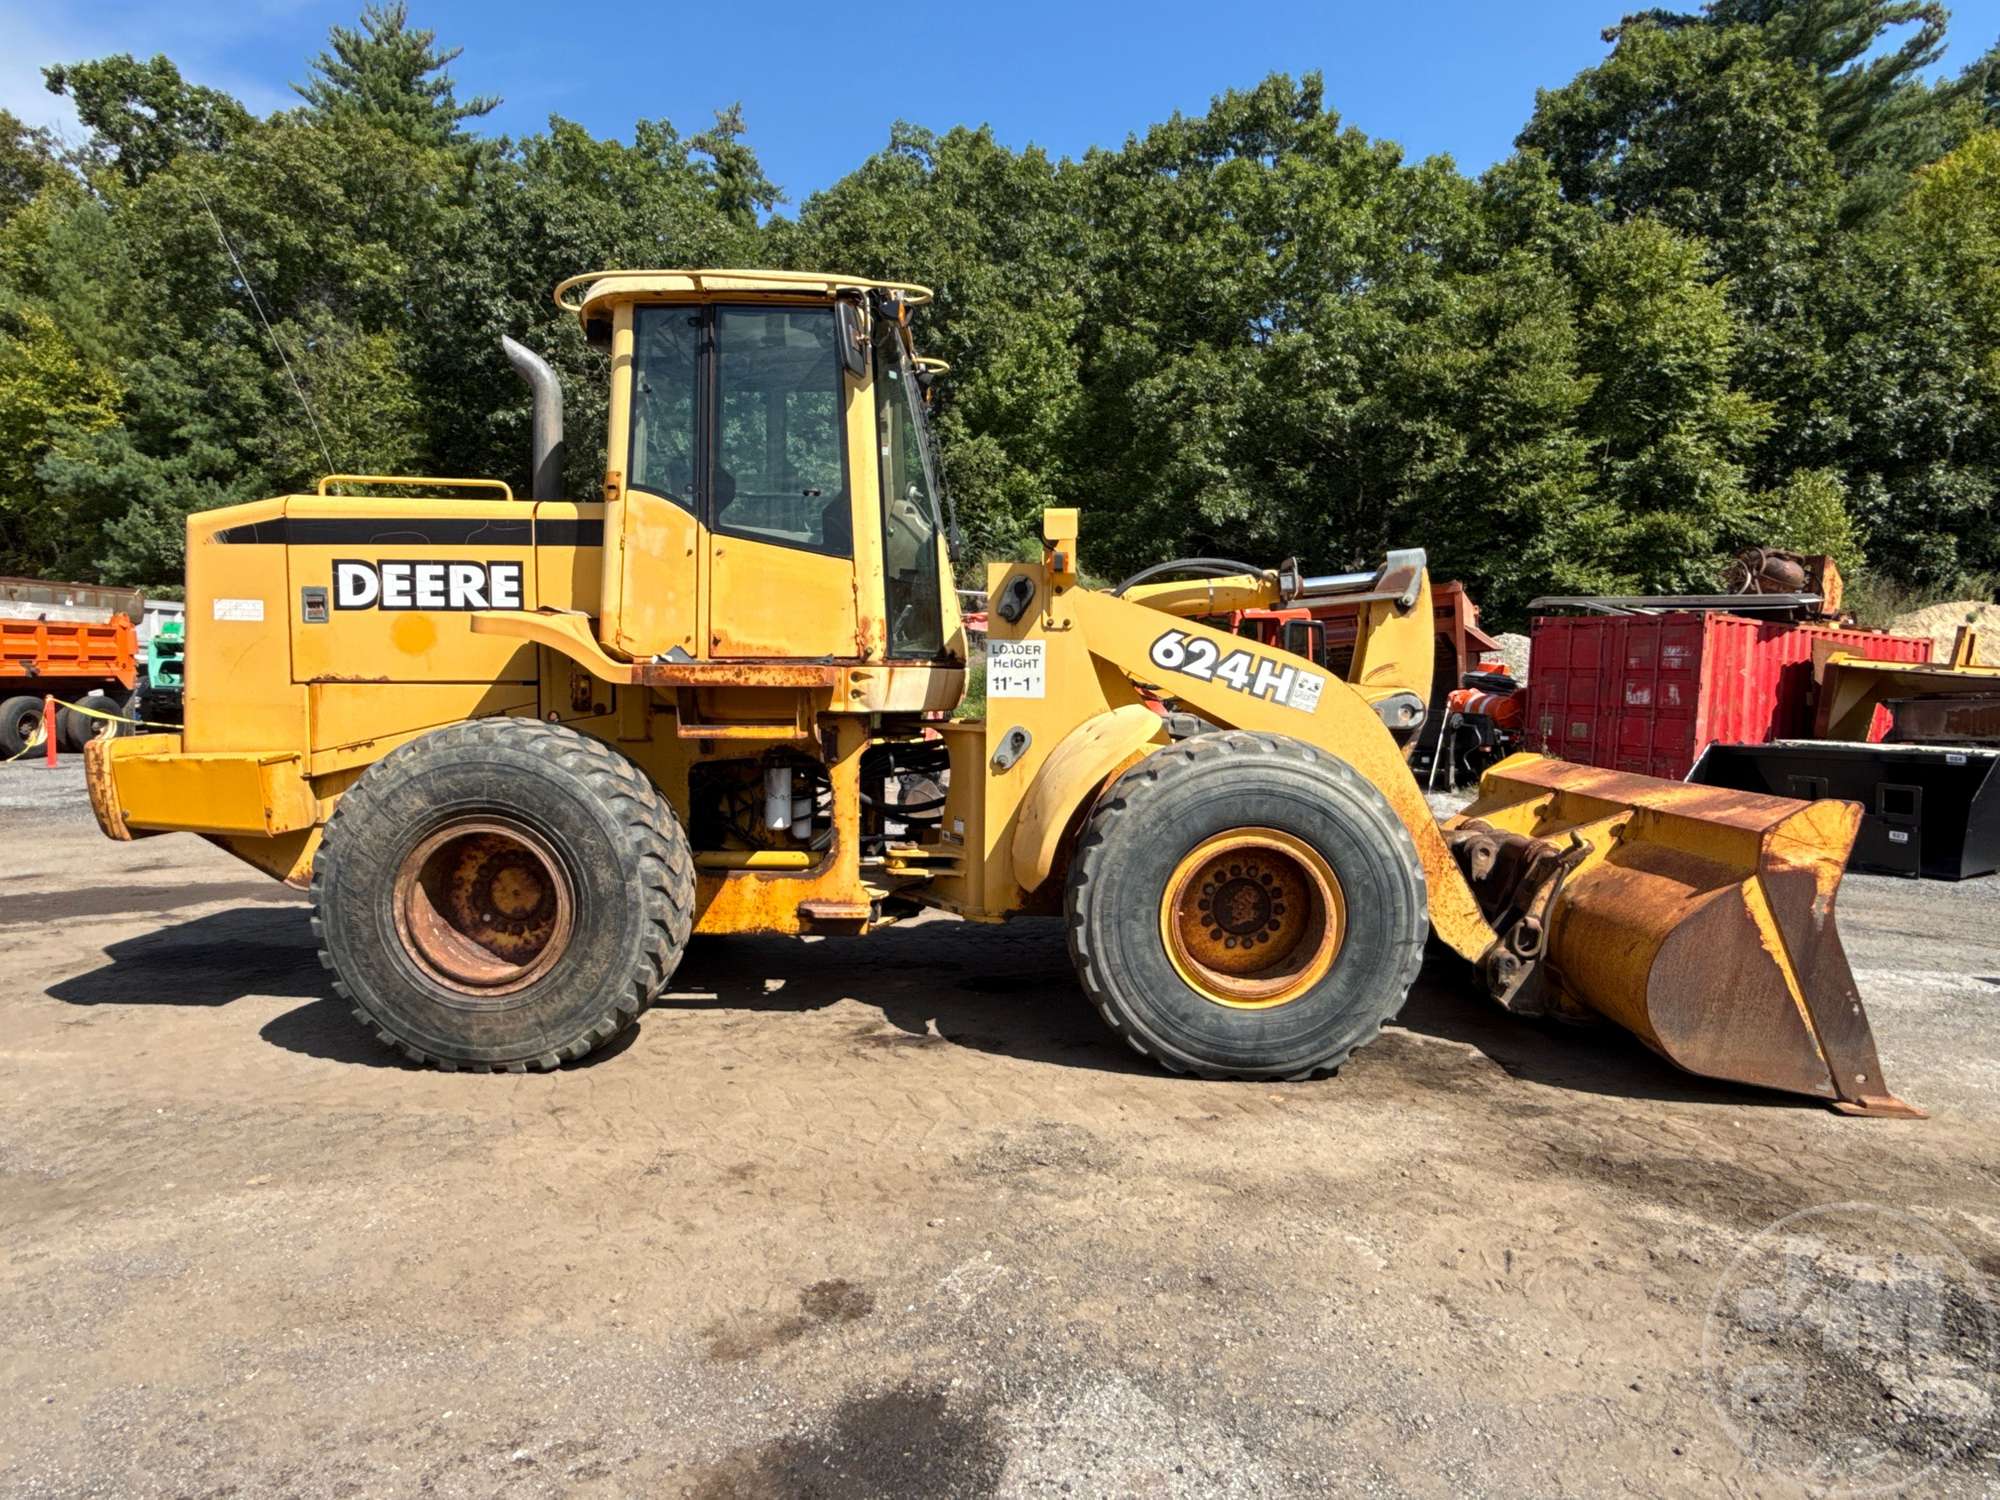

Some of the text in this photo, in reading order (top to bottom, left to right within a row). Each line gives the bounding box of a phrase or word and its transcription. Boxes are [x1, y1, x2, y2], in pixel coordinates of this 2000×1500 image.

[333, 560, 523, 610] DEERE
[991, 644, 1042, 655] LOADER
[993, 658, 1039, 669] HEIGHT
[1149, 628, 1298, 706] 624H
